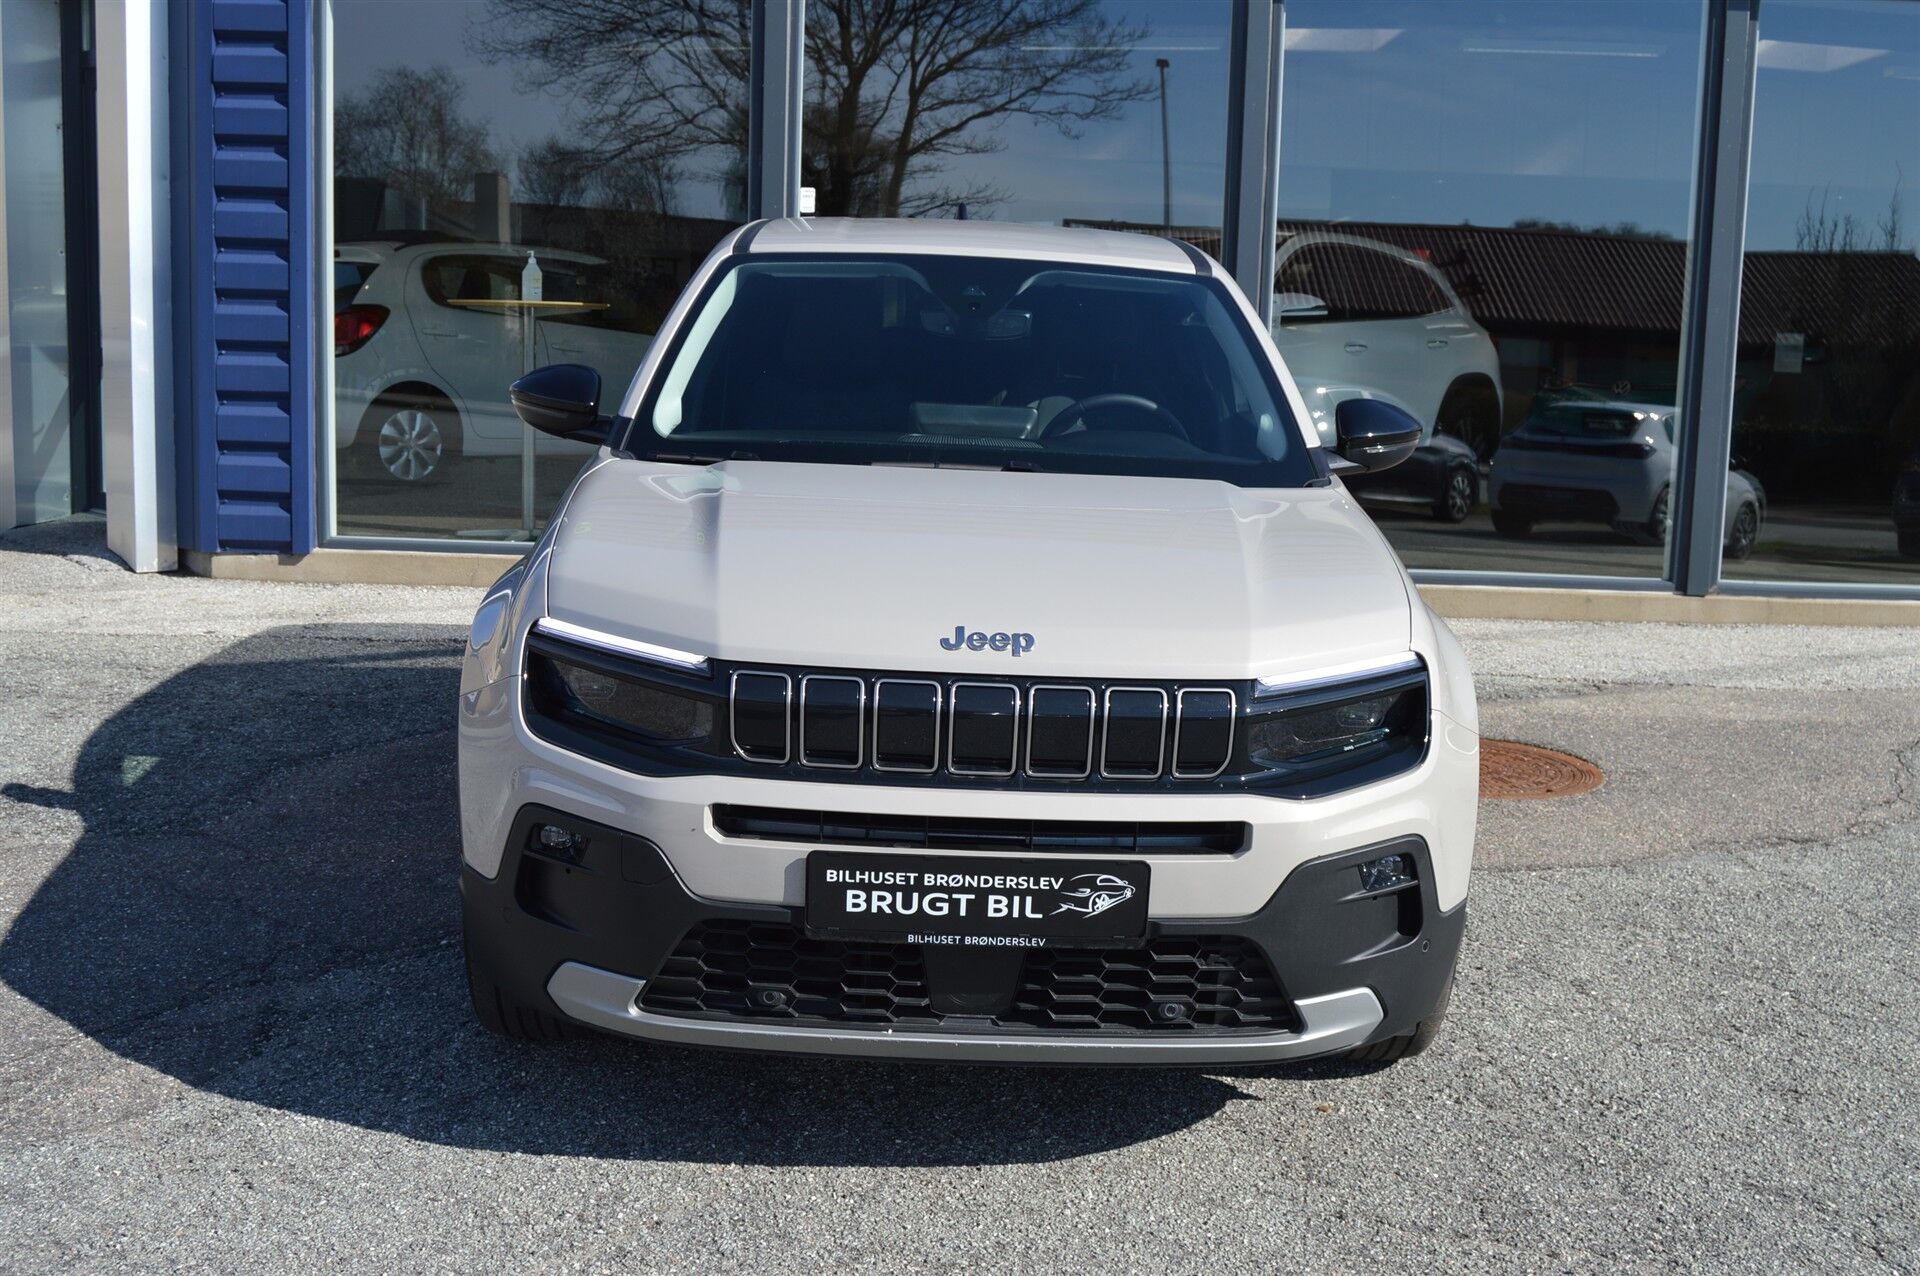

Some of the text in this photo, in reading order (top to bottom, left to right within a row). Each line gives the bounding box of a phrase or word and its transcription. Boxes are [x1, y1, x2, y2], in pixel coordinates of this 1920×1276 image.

[940, 625, 1035, 657] Jeep
[826, 869, 1064, 890] BILHUSET BRØNDERSLEV
[845, 889, 1044, 919] BRUGT BIL
[907, 934, 1046, 947] BILHUSET BRØNDERSLEV
